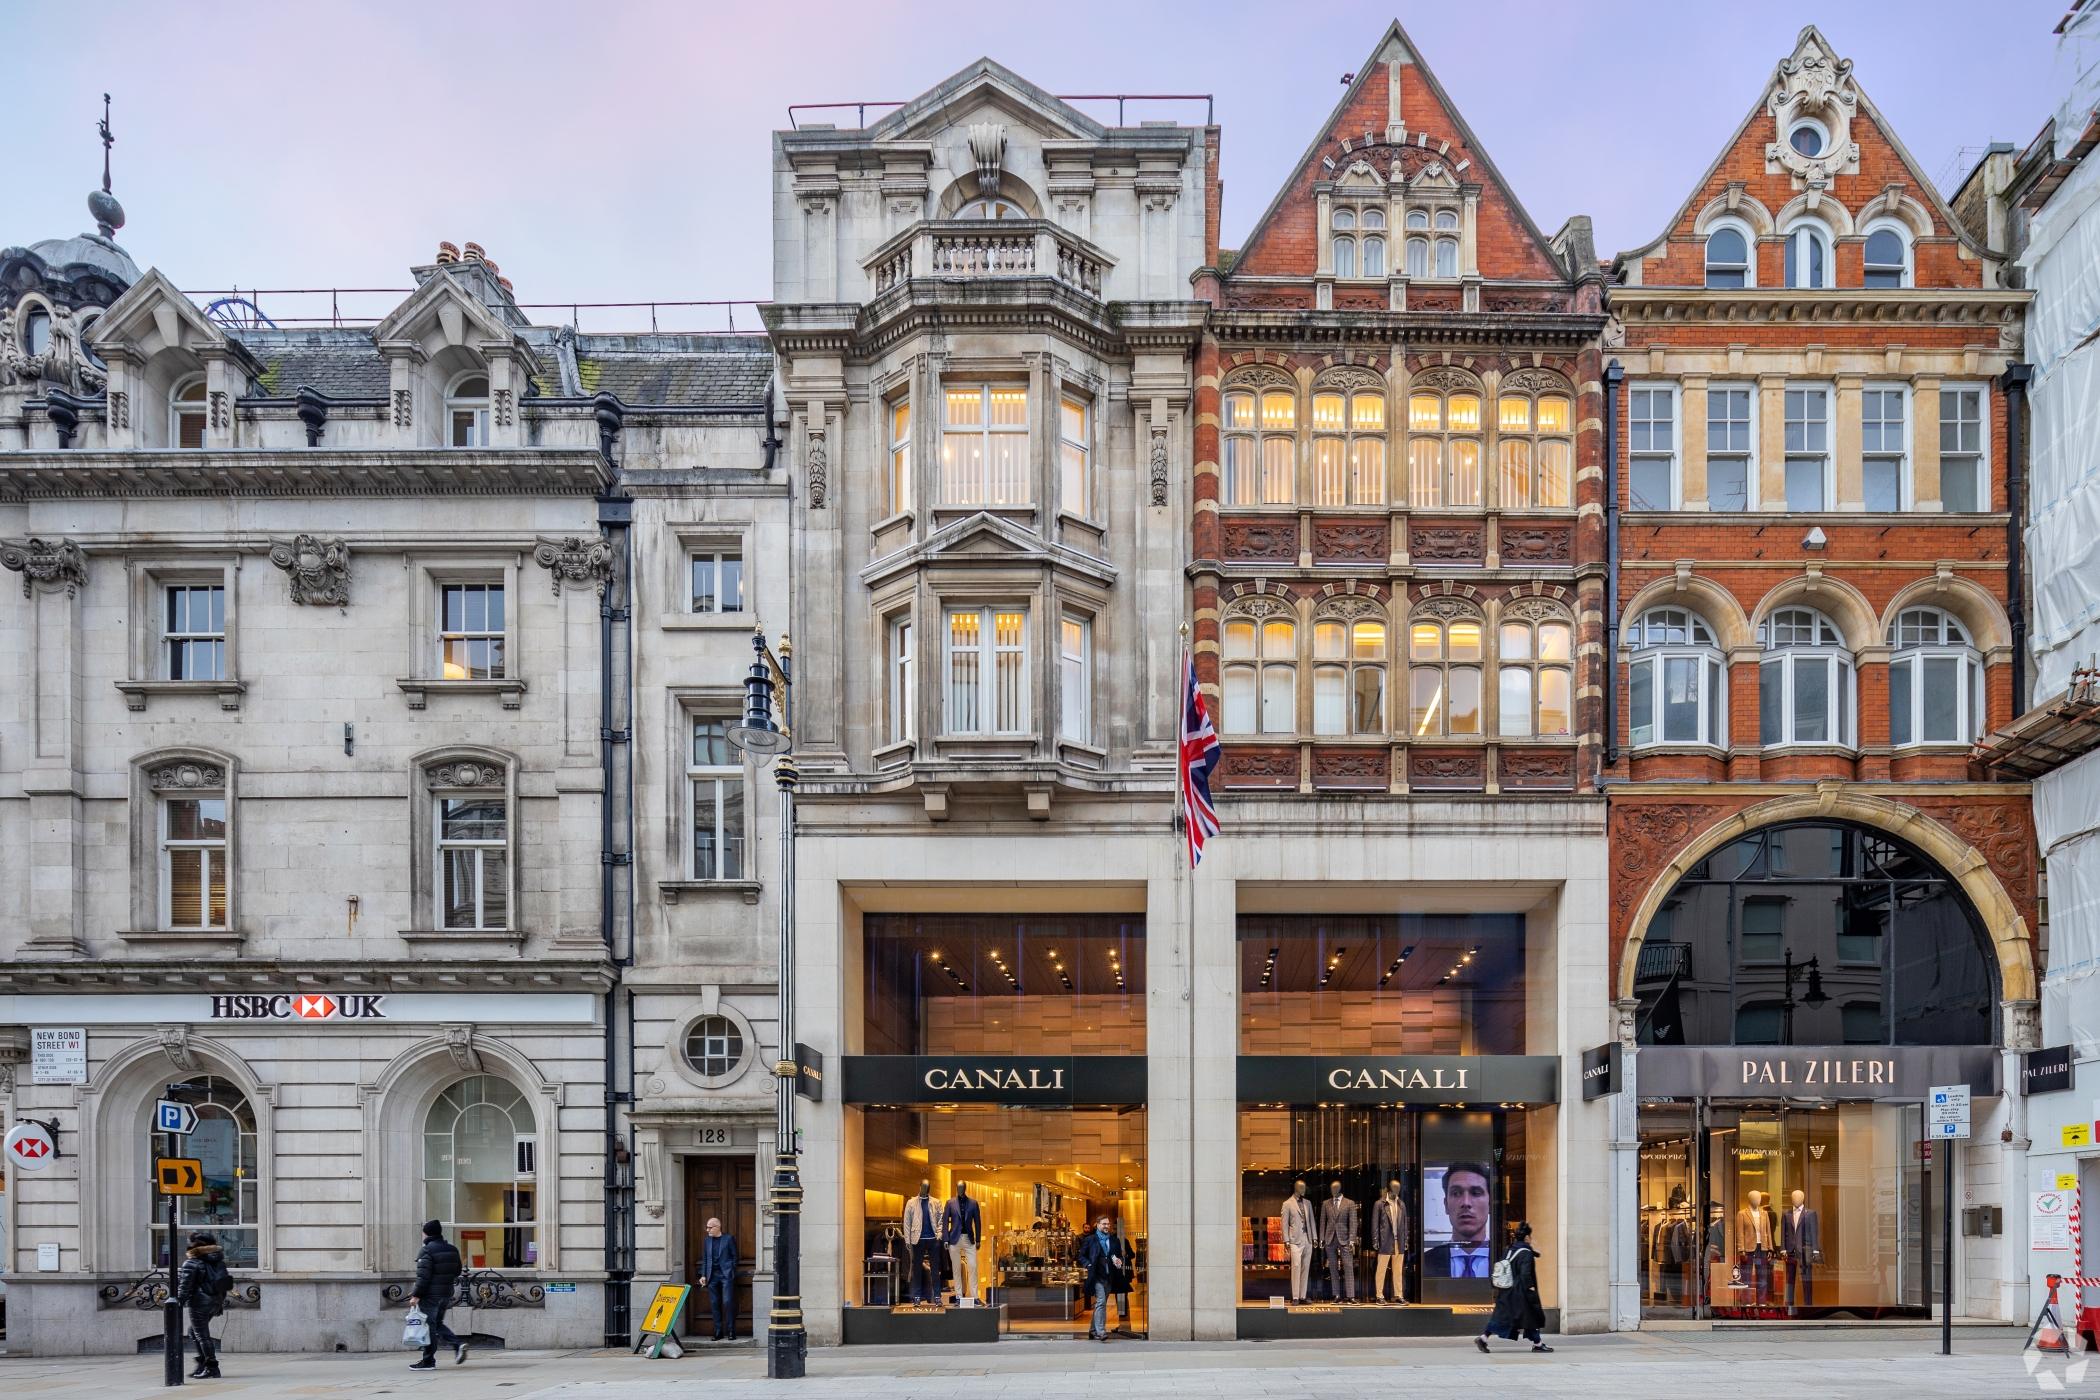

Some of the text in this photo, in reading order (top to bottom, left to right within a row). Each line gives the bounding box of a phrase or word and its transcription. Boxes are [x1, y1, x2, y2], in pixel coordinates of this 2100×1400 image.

[1796, 71, 1832, 91] 1899
[210, 995, 386, 1018] HSBC UK
[37, 1032, 80, 1040] NEW BOND
[37, 1042, 65, 1050] STREET
[803, 1065, 822, 1080] CANALI
[924, 1068, 1064, 1090] CANALI
[1328, 1068, 1469, 1090] CANALI
[1583, 1063, 1609, 1080] CANALI
[1742, 1060, 1894, 1084] PAL ZILERI
[2022, 1062, 2068, 1079] PAL ZILERI
[165, 1107, 179, 1127] P
[698, 1128, 726, 1144] 128
